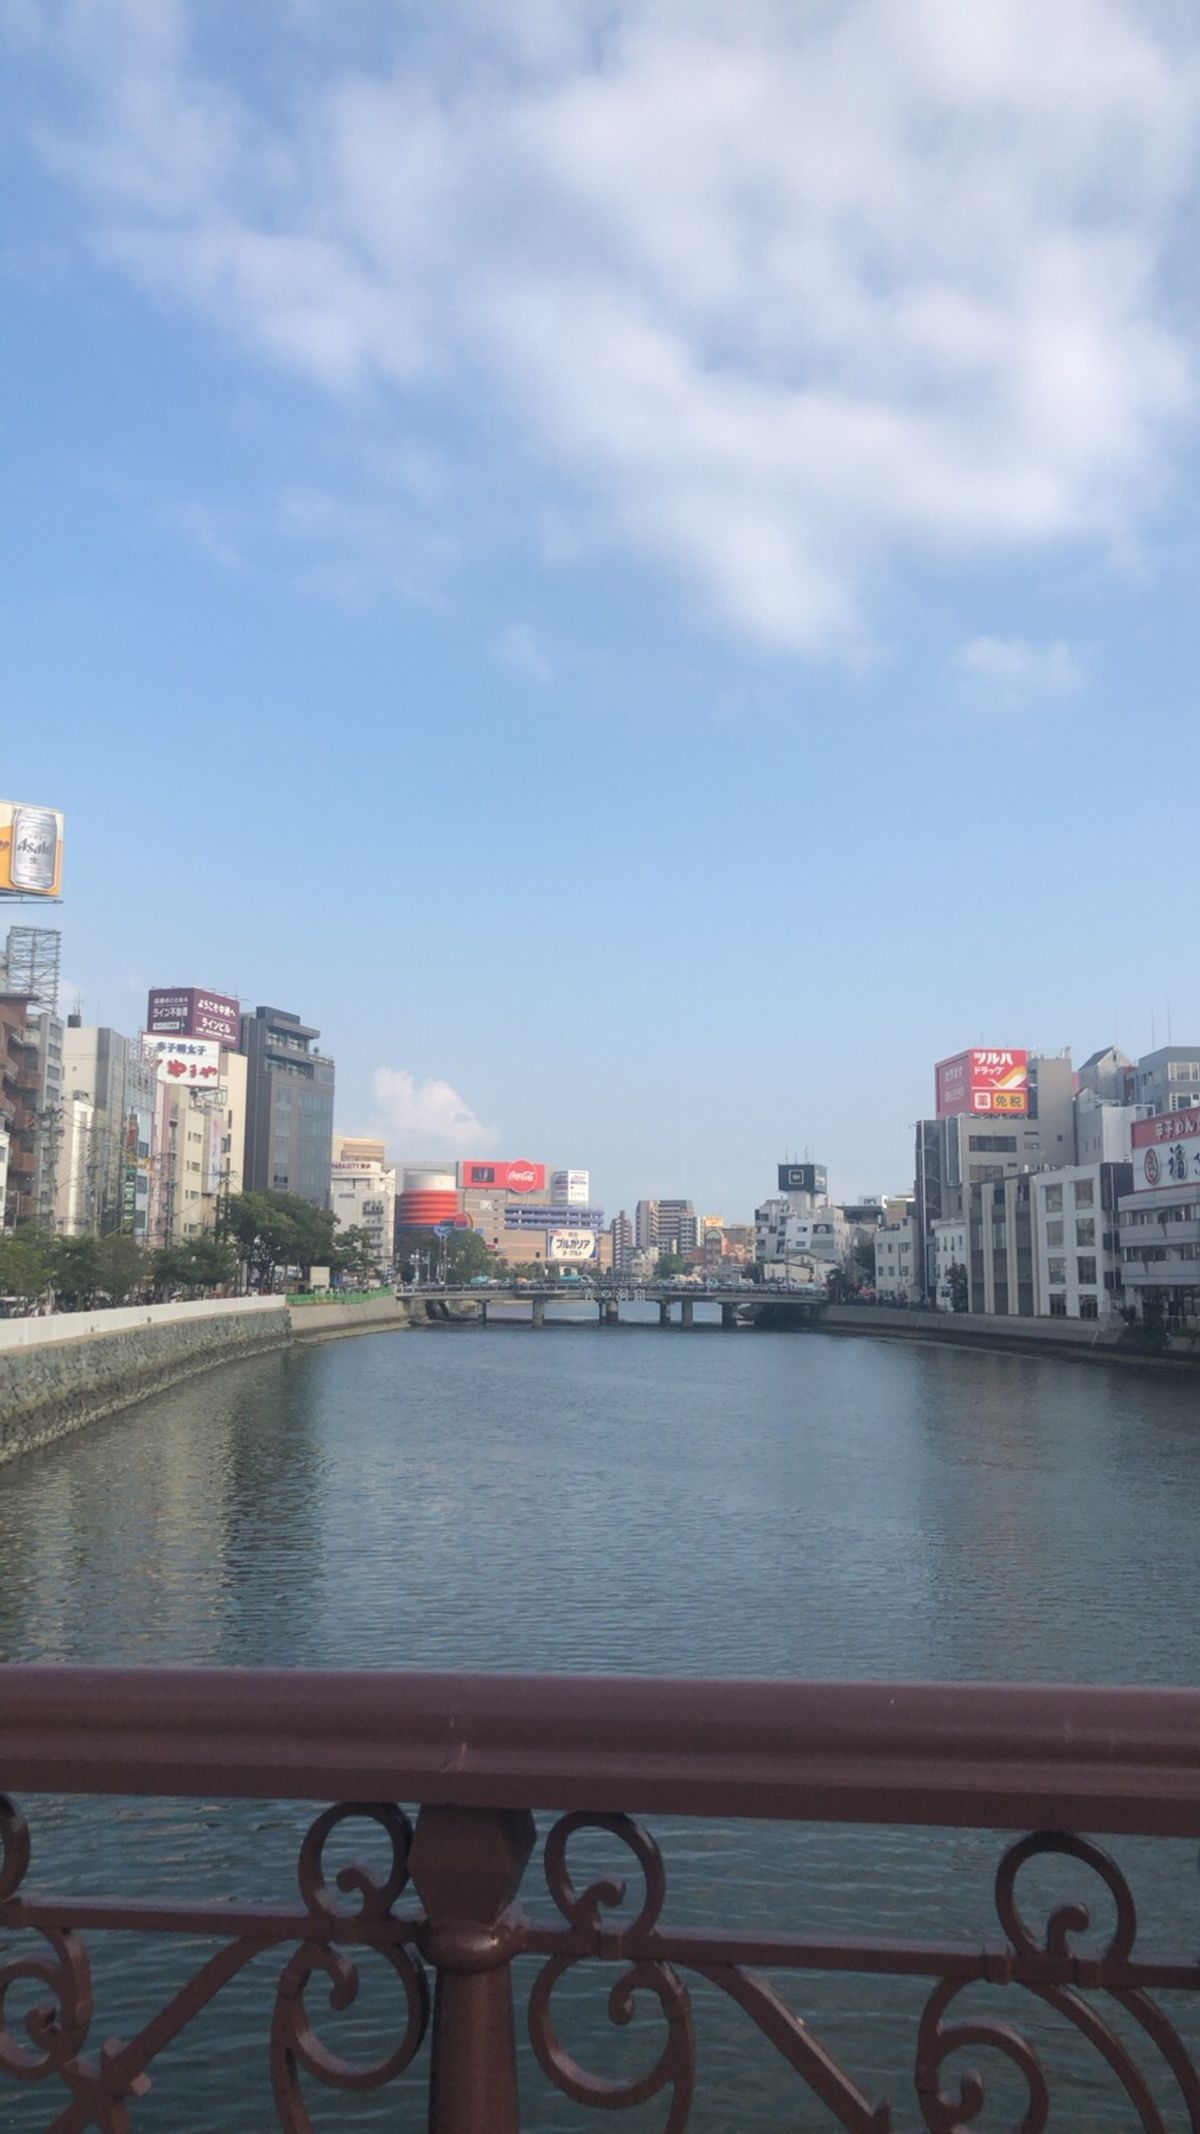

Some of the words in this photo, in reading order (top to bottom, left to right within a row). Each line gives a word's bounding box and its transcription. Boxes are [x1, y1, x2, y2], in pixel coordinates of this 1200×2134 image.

[17, 838, 53, 857] Asahi
[201, 1017, 231, 1034] ラインビル
[973, 1052, 1014, 1065] ツルハ
[974, 1066, 1005, 1076] ドラッグ
[555, 1238, 591, 1250] ブルガリア
